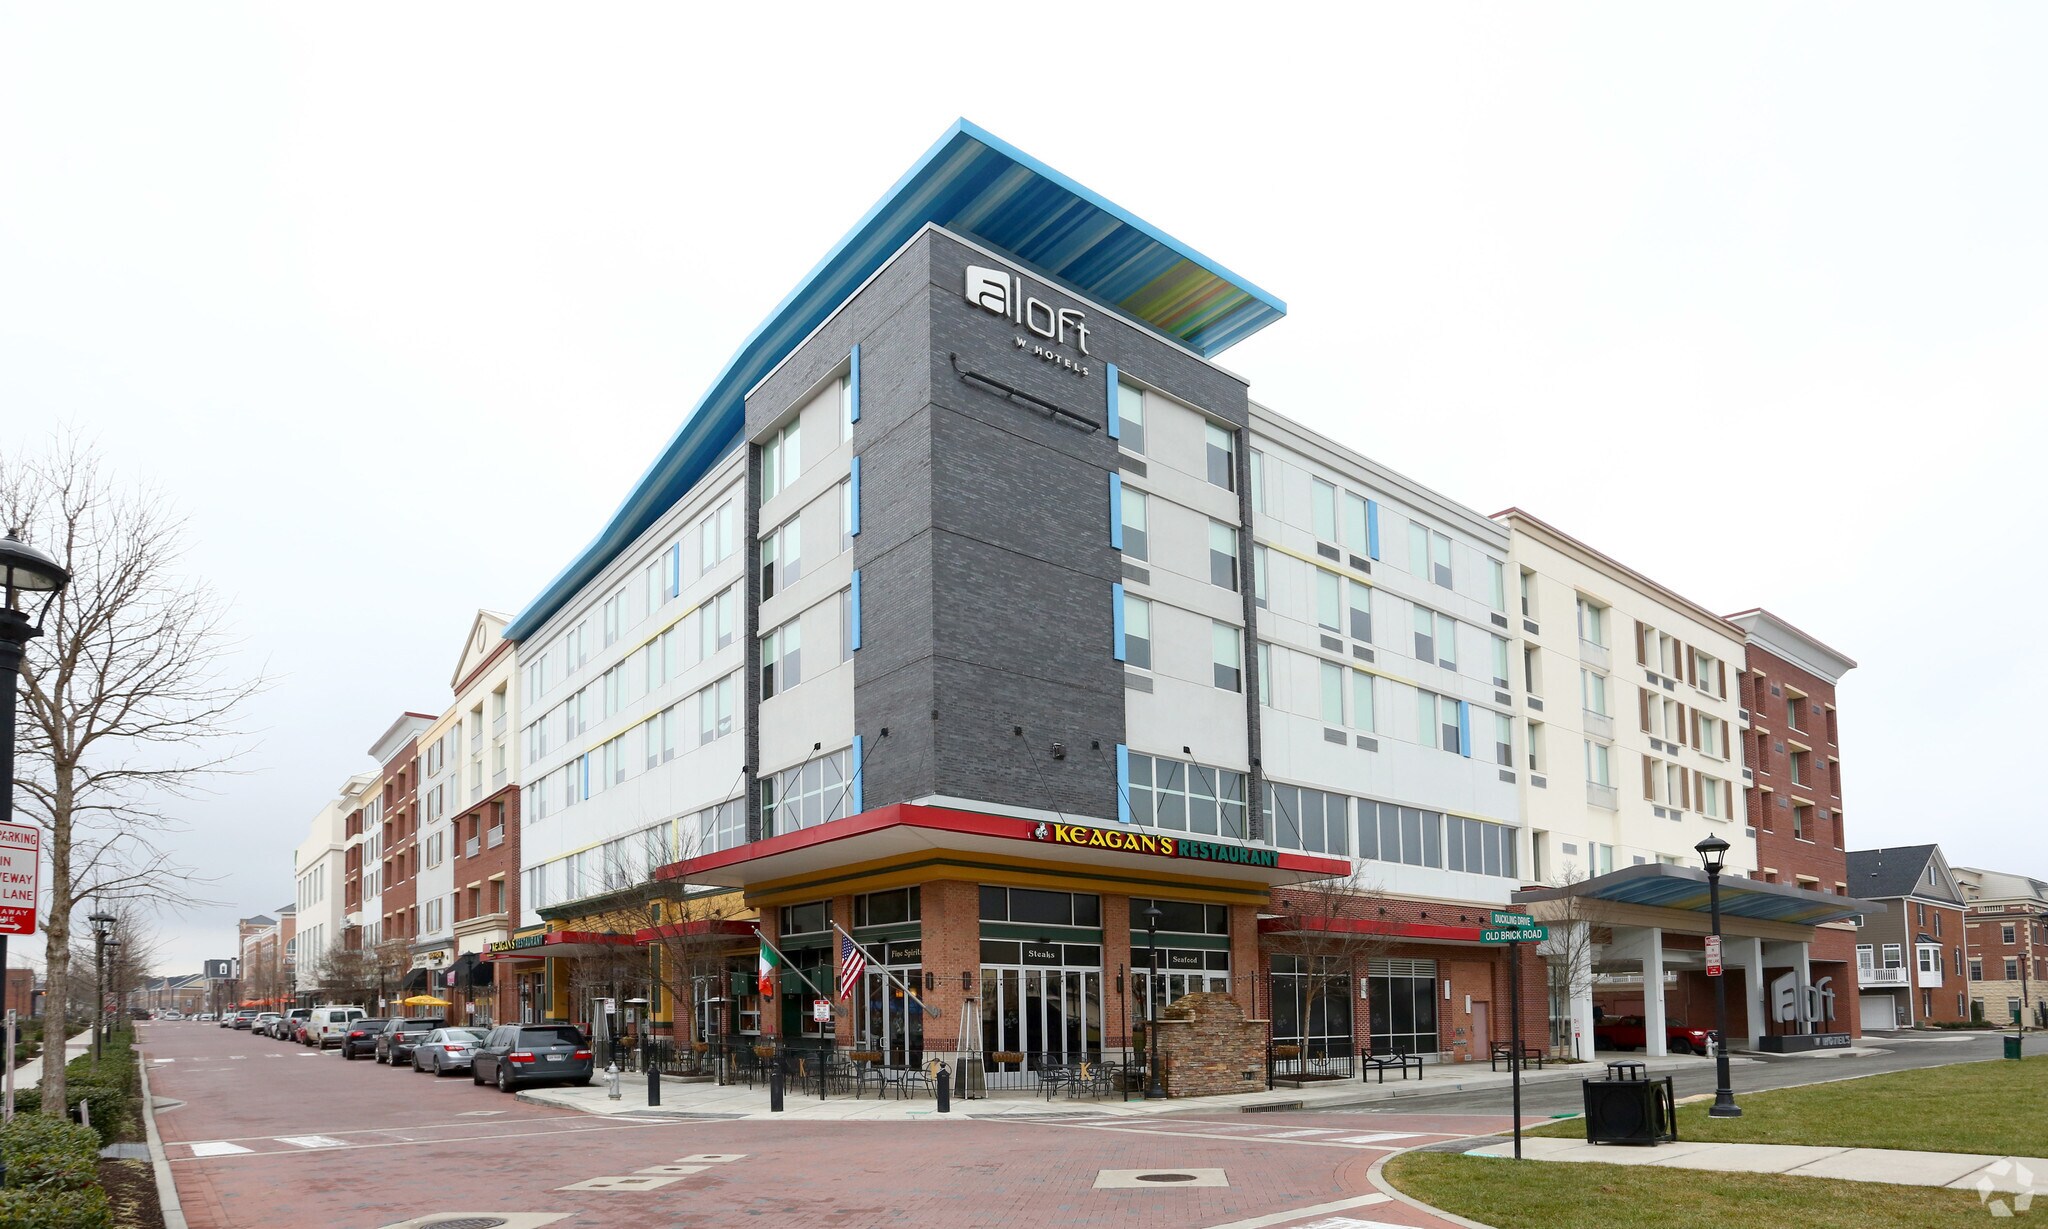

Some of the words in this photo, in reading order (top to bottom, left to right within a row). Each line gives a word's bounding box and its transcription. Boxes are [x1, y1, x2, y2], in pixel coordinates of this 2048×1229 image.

[966, 265, 1091, 355] aloft
[1016, 336, 1027, 348] W
[1035, 345, 1089, 376] HOTELS
[1053, 823, 1173, 855] KEAGAN'S
[1178, 839, 1279, 868] RESTAURANT
[3, 889, 34, 901] LANE
[1, 908, 28, 916] AWAY
[1494, 914, 1517, 925] DUCKLING
[1517, 916, 1531, 926] DRIVE
[1485, 931, 1500, 941] OLD
[1500, 930, 1521, 940] BRICK
[1523, 929, 1542, 939] ROAD
[1028, 949, 1055, 959] Steaks
[1172, 955, 1198, 964] Seafood
